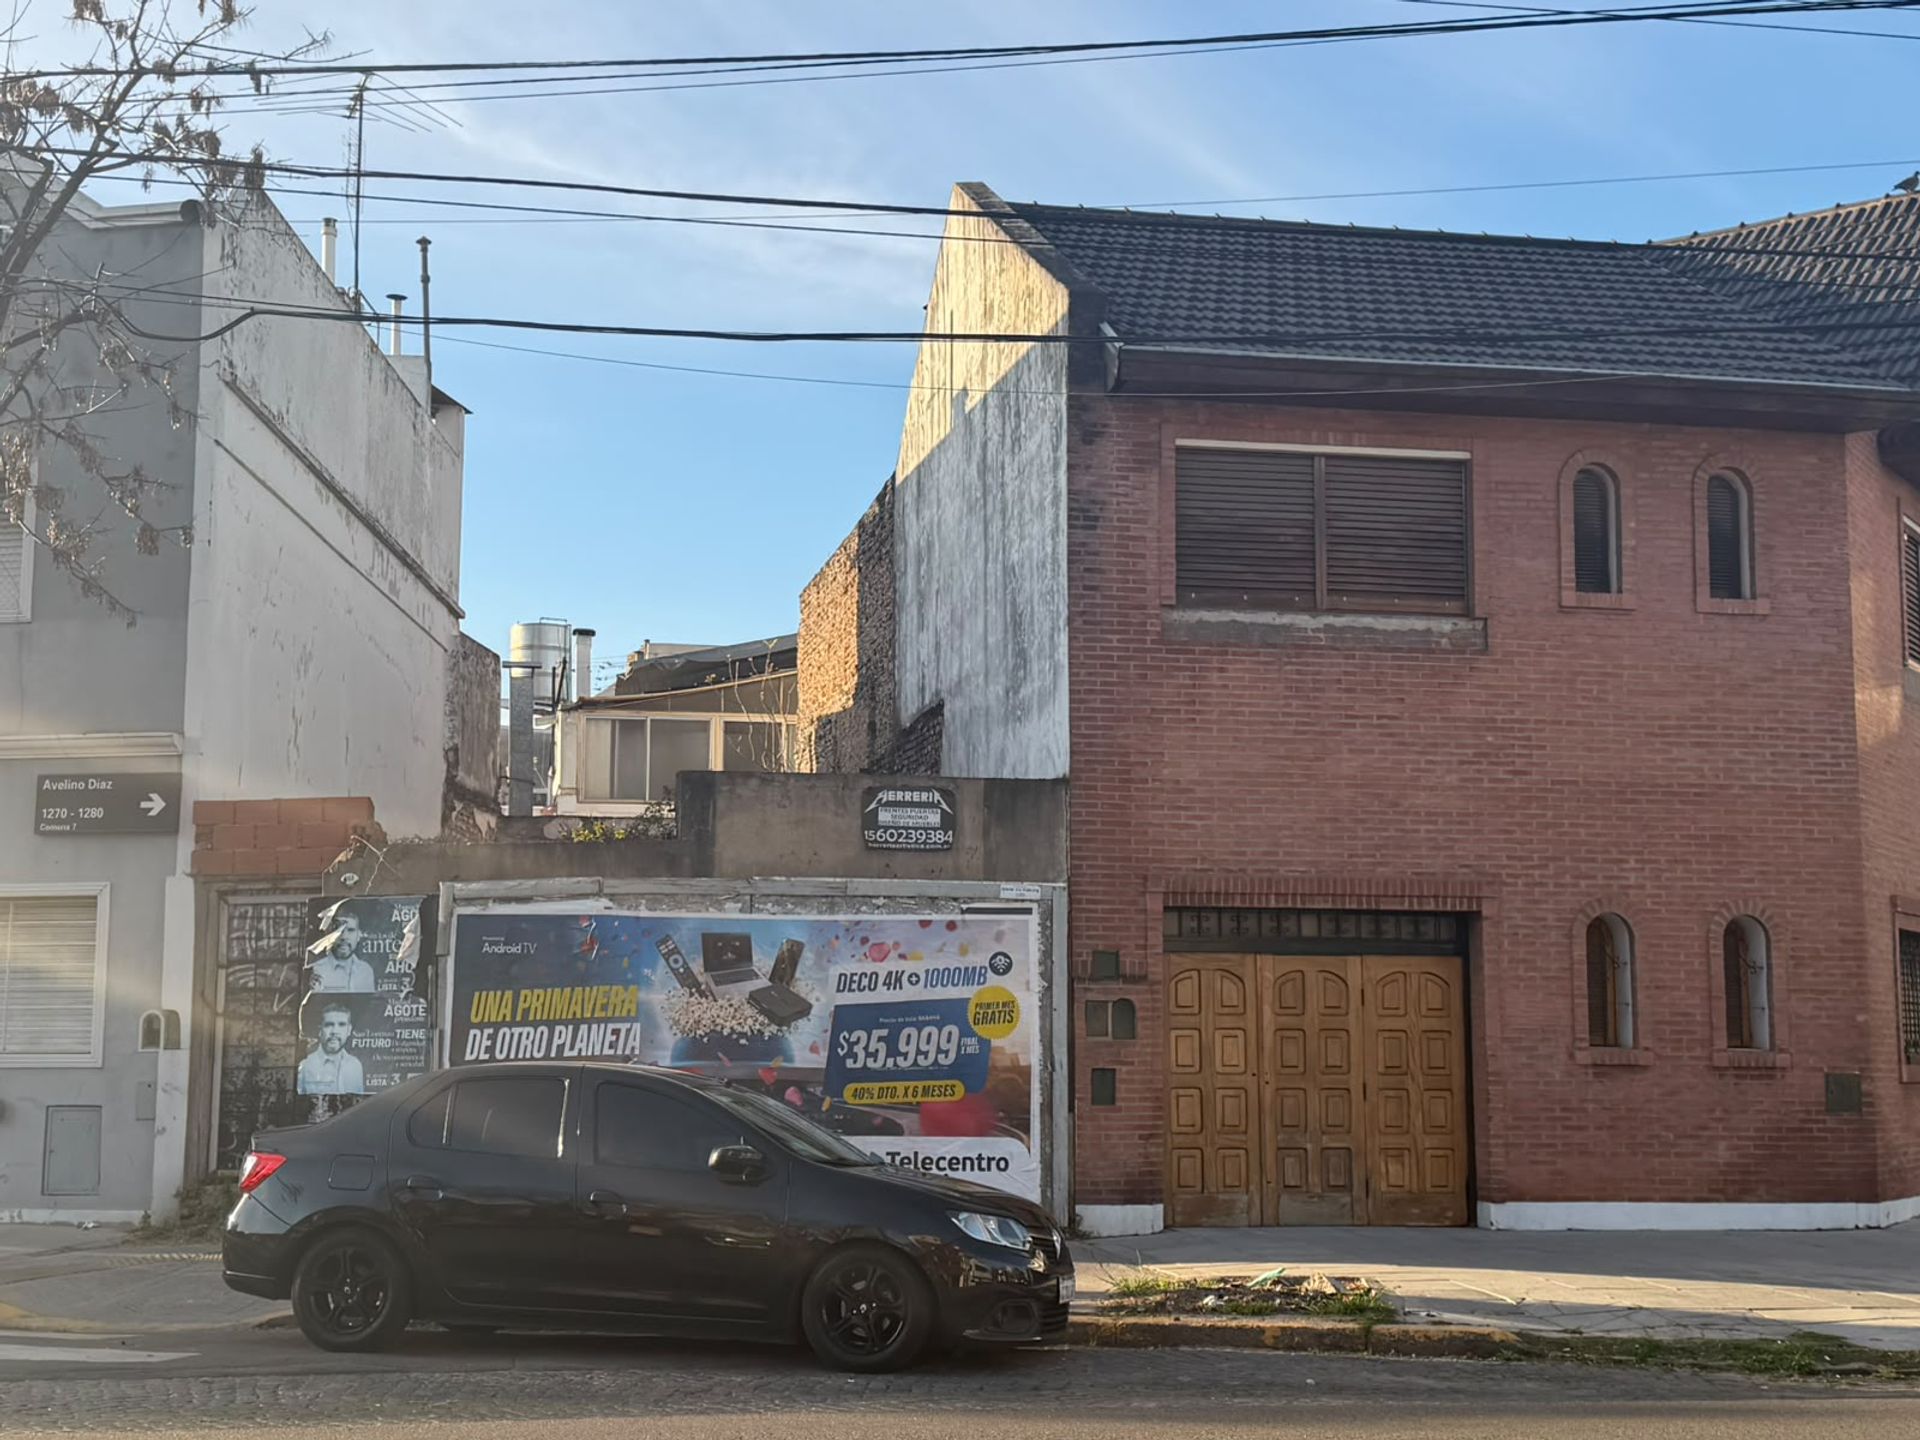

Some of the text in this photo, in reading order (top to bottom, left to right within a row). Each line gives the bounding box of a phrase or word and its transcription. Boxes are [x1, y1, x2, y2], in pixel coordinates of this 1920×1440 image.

[42, 779, 85, 790] Avelino
[42, 808, 67, 819] 1270
[79, 807, 104, 818] 1280
[864, 829, 953, 843] 1560239384
[482, 942, 537, 953] Android TV
[835, 970, 878, 994] DECO
[882, 969, 904, 991] 4K
[923, 965, 988, 988] 1000MB
[378, 983, 398, 991] LISTA
[384, 1004, 427, 1017] AGOTE
[470, 985, 639, 1023] UNA PRIMAVERA
[974, 1000, 1015, 1010] PRIMER MES
[973, 1009, 1014, 1026] GRATIS
[396, 1029, 426, 1039] TIENE
[352, 1038, 392, 1048] FUTURO
[464, 1022, 641, 1061] DE OTRO PLANETA
[837, 1024, 960, 1068] $35.999
[391, 1073, 401, 1085] 3
[852, 1084, 955, 1100] 40% DTO. X 6 MESES
[886, 1151, 1009, 1172] Telecentro
